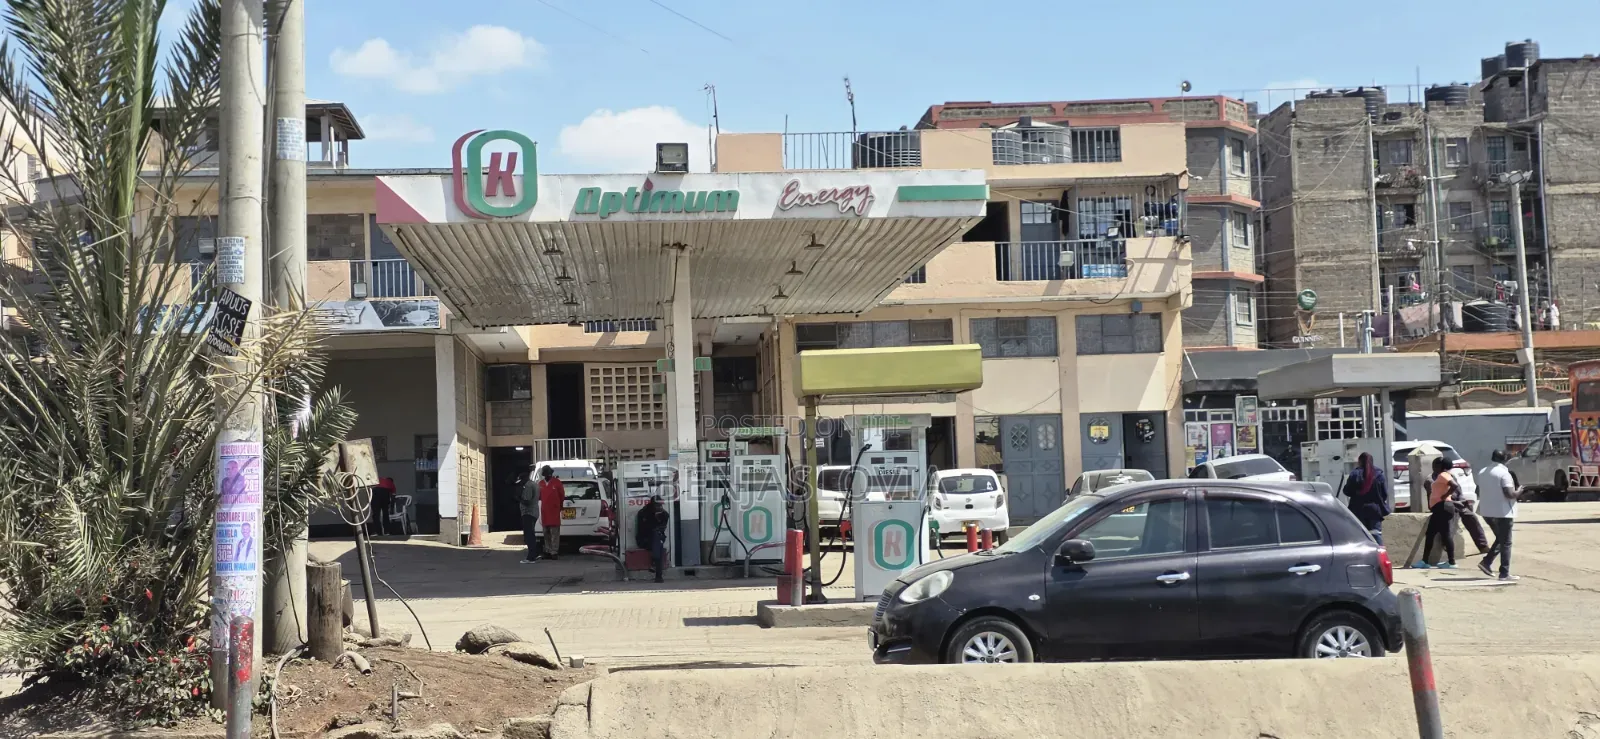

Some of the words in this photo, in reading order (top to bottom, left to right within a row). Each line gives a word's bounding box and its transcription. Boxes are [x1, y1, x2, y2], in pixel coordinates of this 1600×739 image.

[574, 177, 740, 219] Optimum
[777, 178, 876, 217] Energy
[218, 289, 249, 315] ADULTS
[212, 306, 242, 337] KCSE
[1292, 334, 1323, 344] GUINNESS
[245, 479, 254, 491] 28
[217, 550, 227, 561] 30
